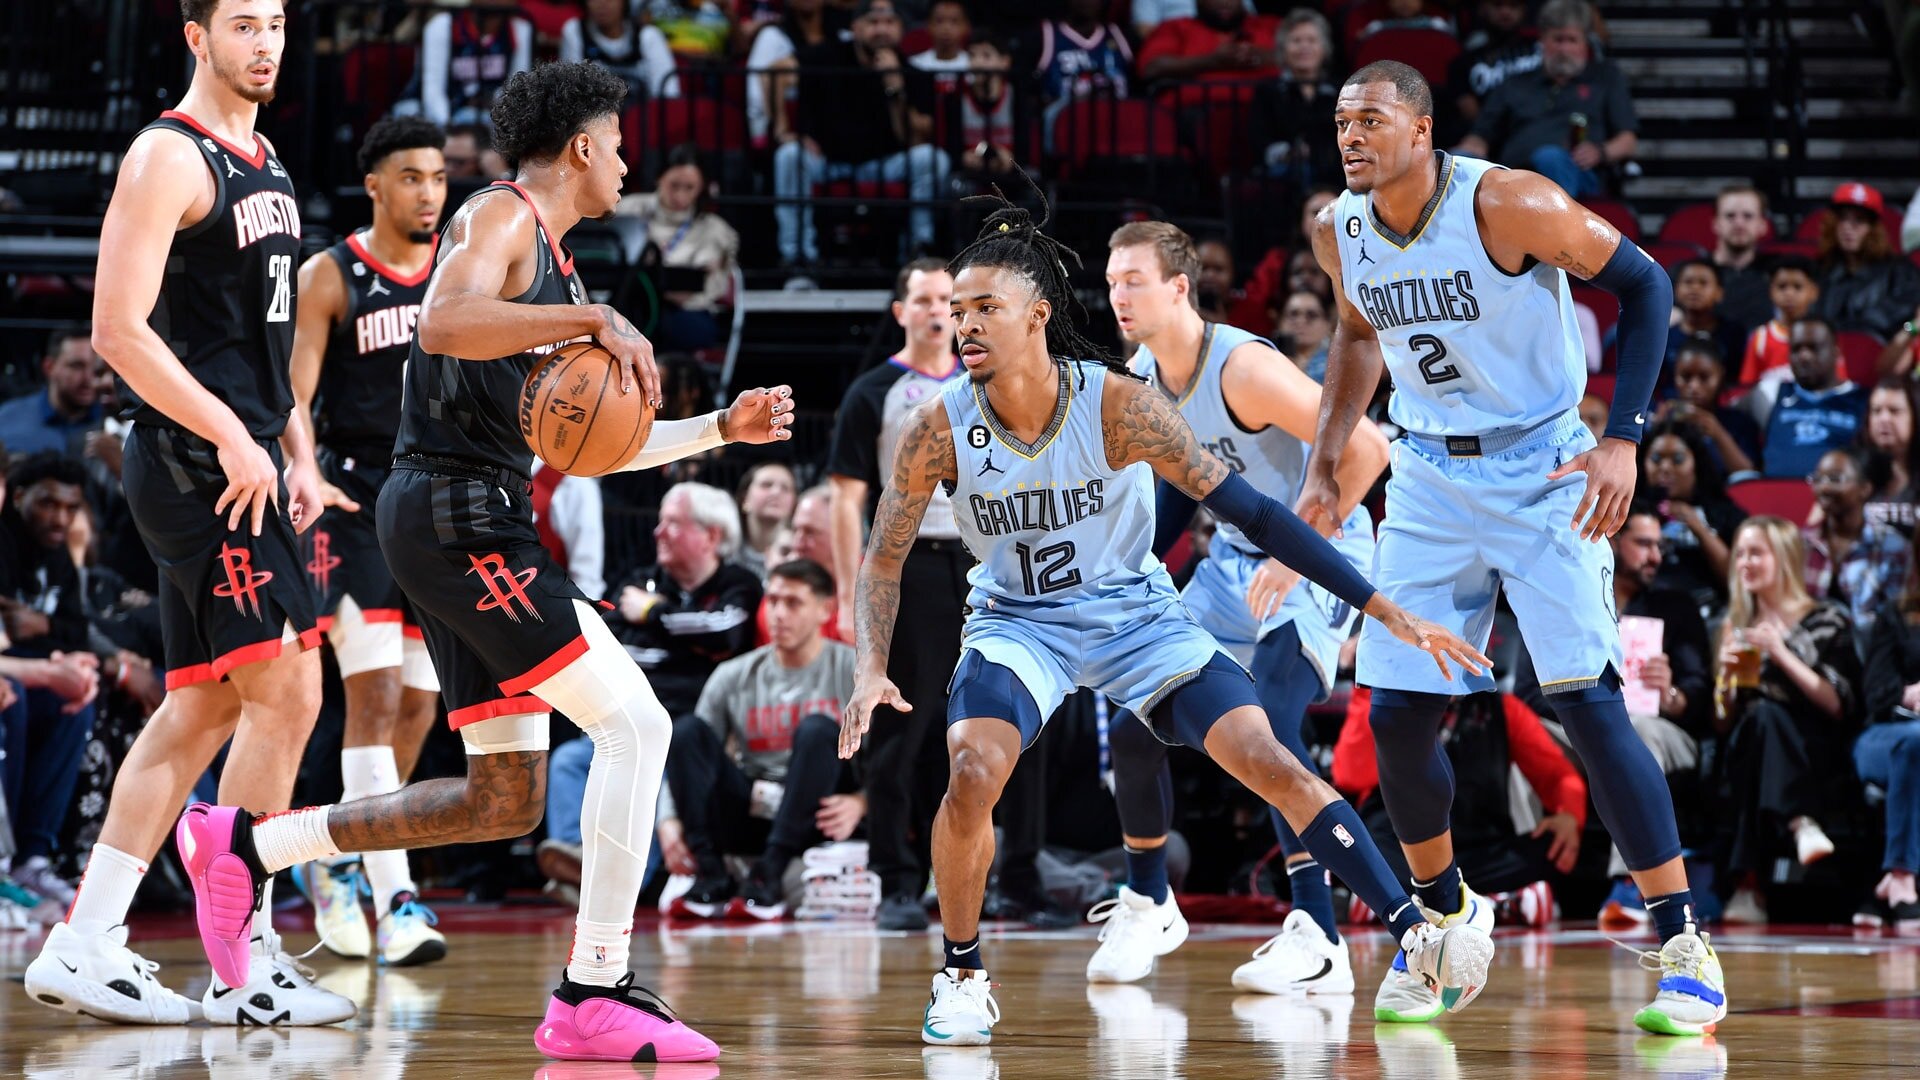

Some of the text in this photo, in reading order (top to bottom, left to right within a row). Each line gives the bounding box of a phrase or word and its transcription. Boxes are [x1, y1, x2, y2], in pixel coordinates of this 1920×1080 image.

[266, 254, 292, 323] 28
[1357, 270, 1481, 331] GRIZZLIES
[1408, 333, 1462, 386] 2
[972, 428, 986, 447] 6
[969, 478, 1104, 537] GRIZZLIES
[1015, 540, 1083, 597] 12
